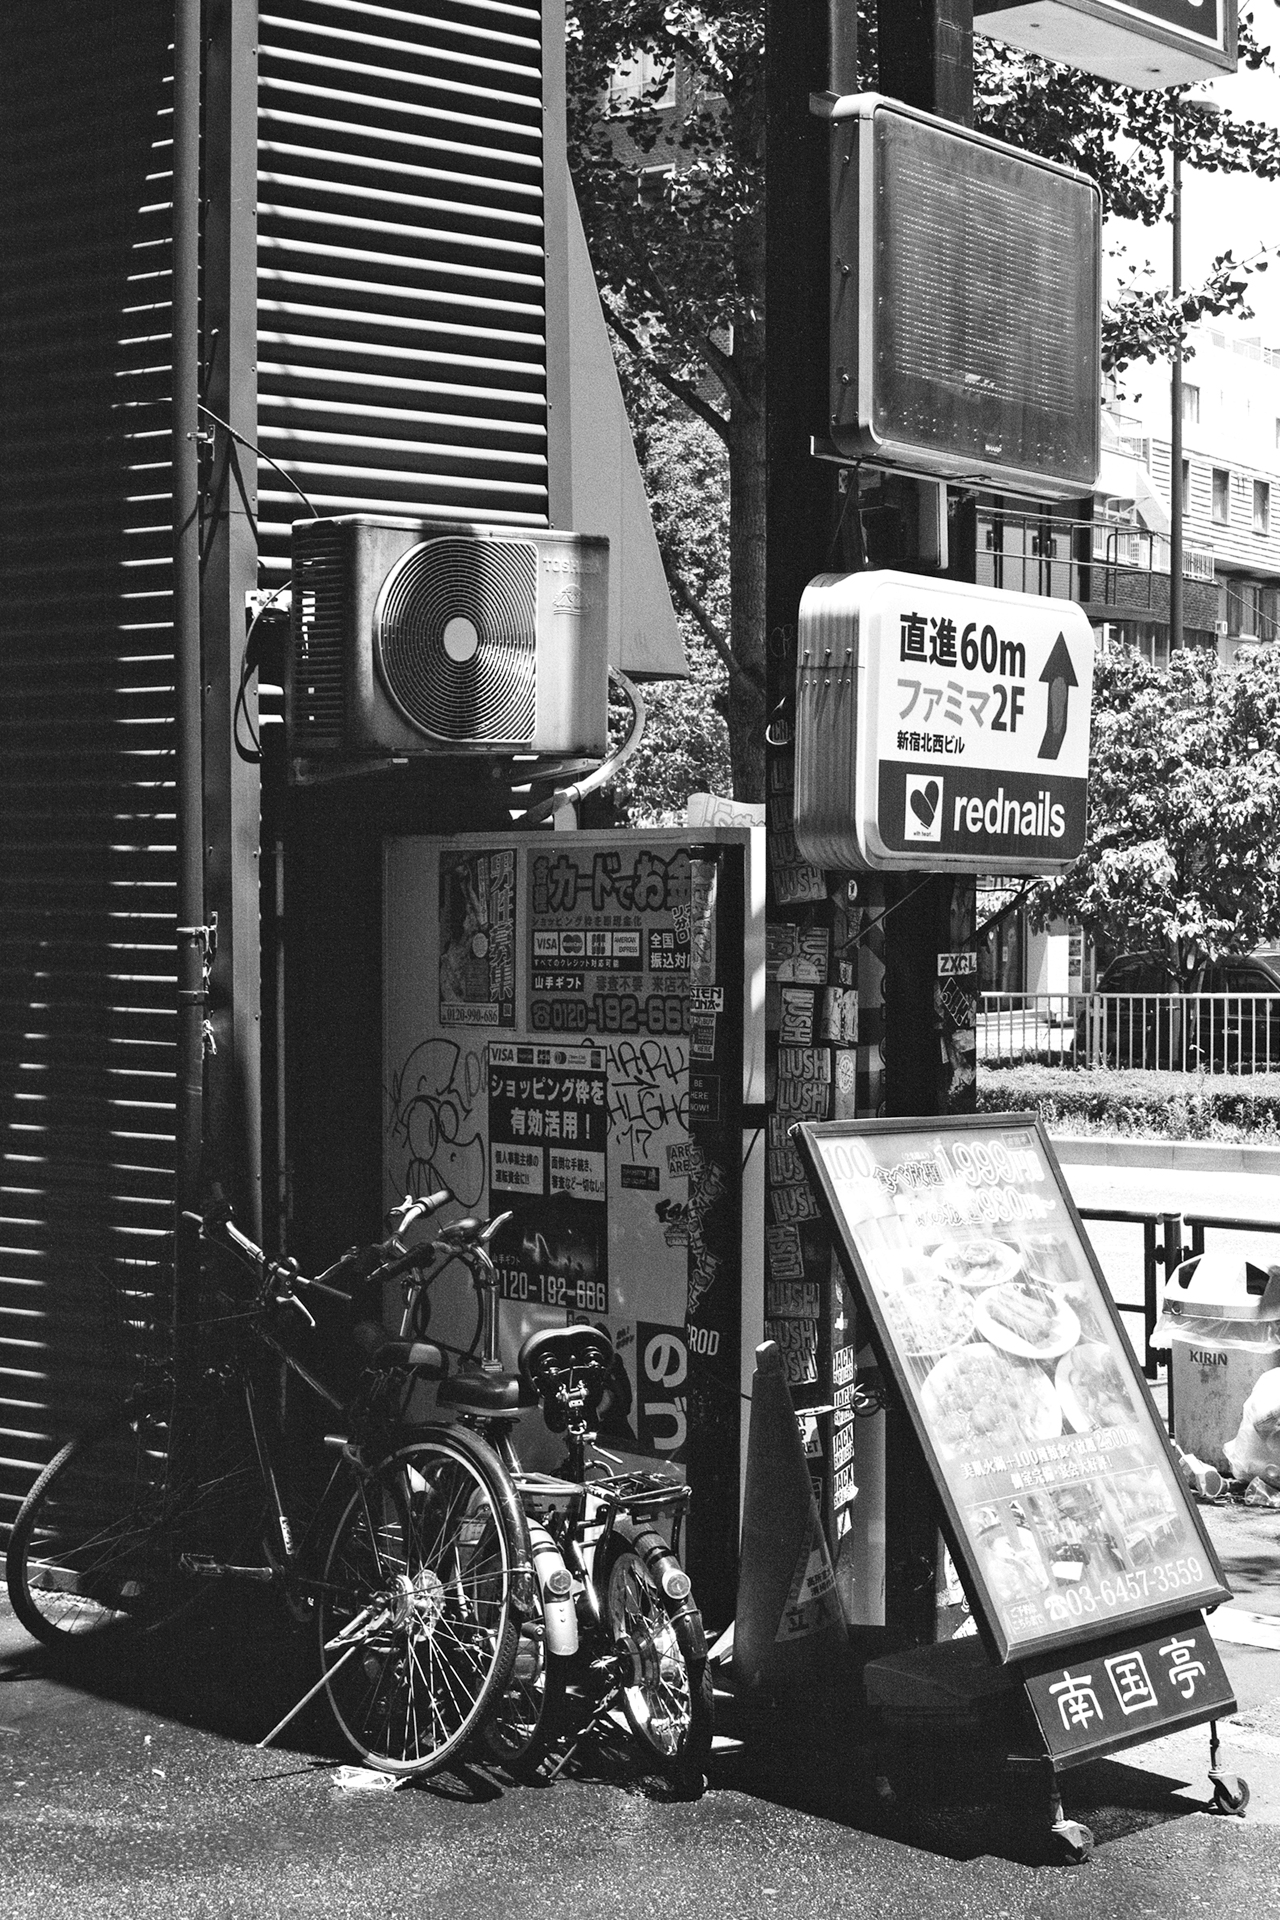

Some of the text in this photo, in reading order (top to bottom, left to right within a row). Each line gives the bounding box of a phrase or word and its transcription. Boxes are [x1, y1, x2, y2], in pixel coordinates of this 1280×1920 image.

[900, 612, 1026, 678] 直進60m
[897, 678, 1025, 733] ファミマ2F
[897, 730, 965, 754] 新宿北西ビル
[954, 787, 1065, 838] rednails
[775, 867, 824, 902] LUSH
[536, 938, 557, 950] VISA
[535, 976, 582, 989] 山手ギフト
[596, 975, 643, 992] 審査不要
[782, 991, 813, 1044] LUSH
[491, 1047, 514, 1062] VISA
[779, 1050, 827, 1081] LUSH
[491, 1074, 604, 1105] ショッピング枠を
[693, 1079, 704, 1088] BE
[779, 1081, 827, 1117] LUSH
[770, 1151, 806, 1183] LUS
[873, 1161, 944, 1194] 食べ放題
[497, 1268, 606, 1311] 120-192-666
[768, 1284, 816, 1313] LUSH
[688, 1323, 720, 1356] ROD
[783, 1350, 815, 1382] SH
[834, 1348, 853, 1372] JACK
[1189, 1350, 1228, 1366] KIRIN
[834, 1425, 853, 1455] JACK
[834, 1465, 853, 1493] JACK
[1066, 1557, 1203, 1616] 03-6457-3559
[1049, 1637, 1206, 1730] 南国亭
